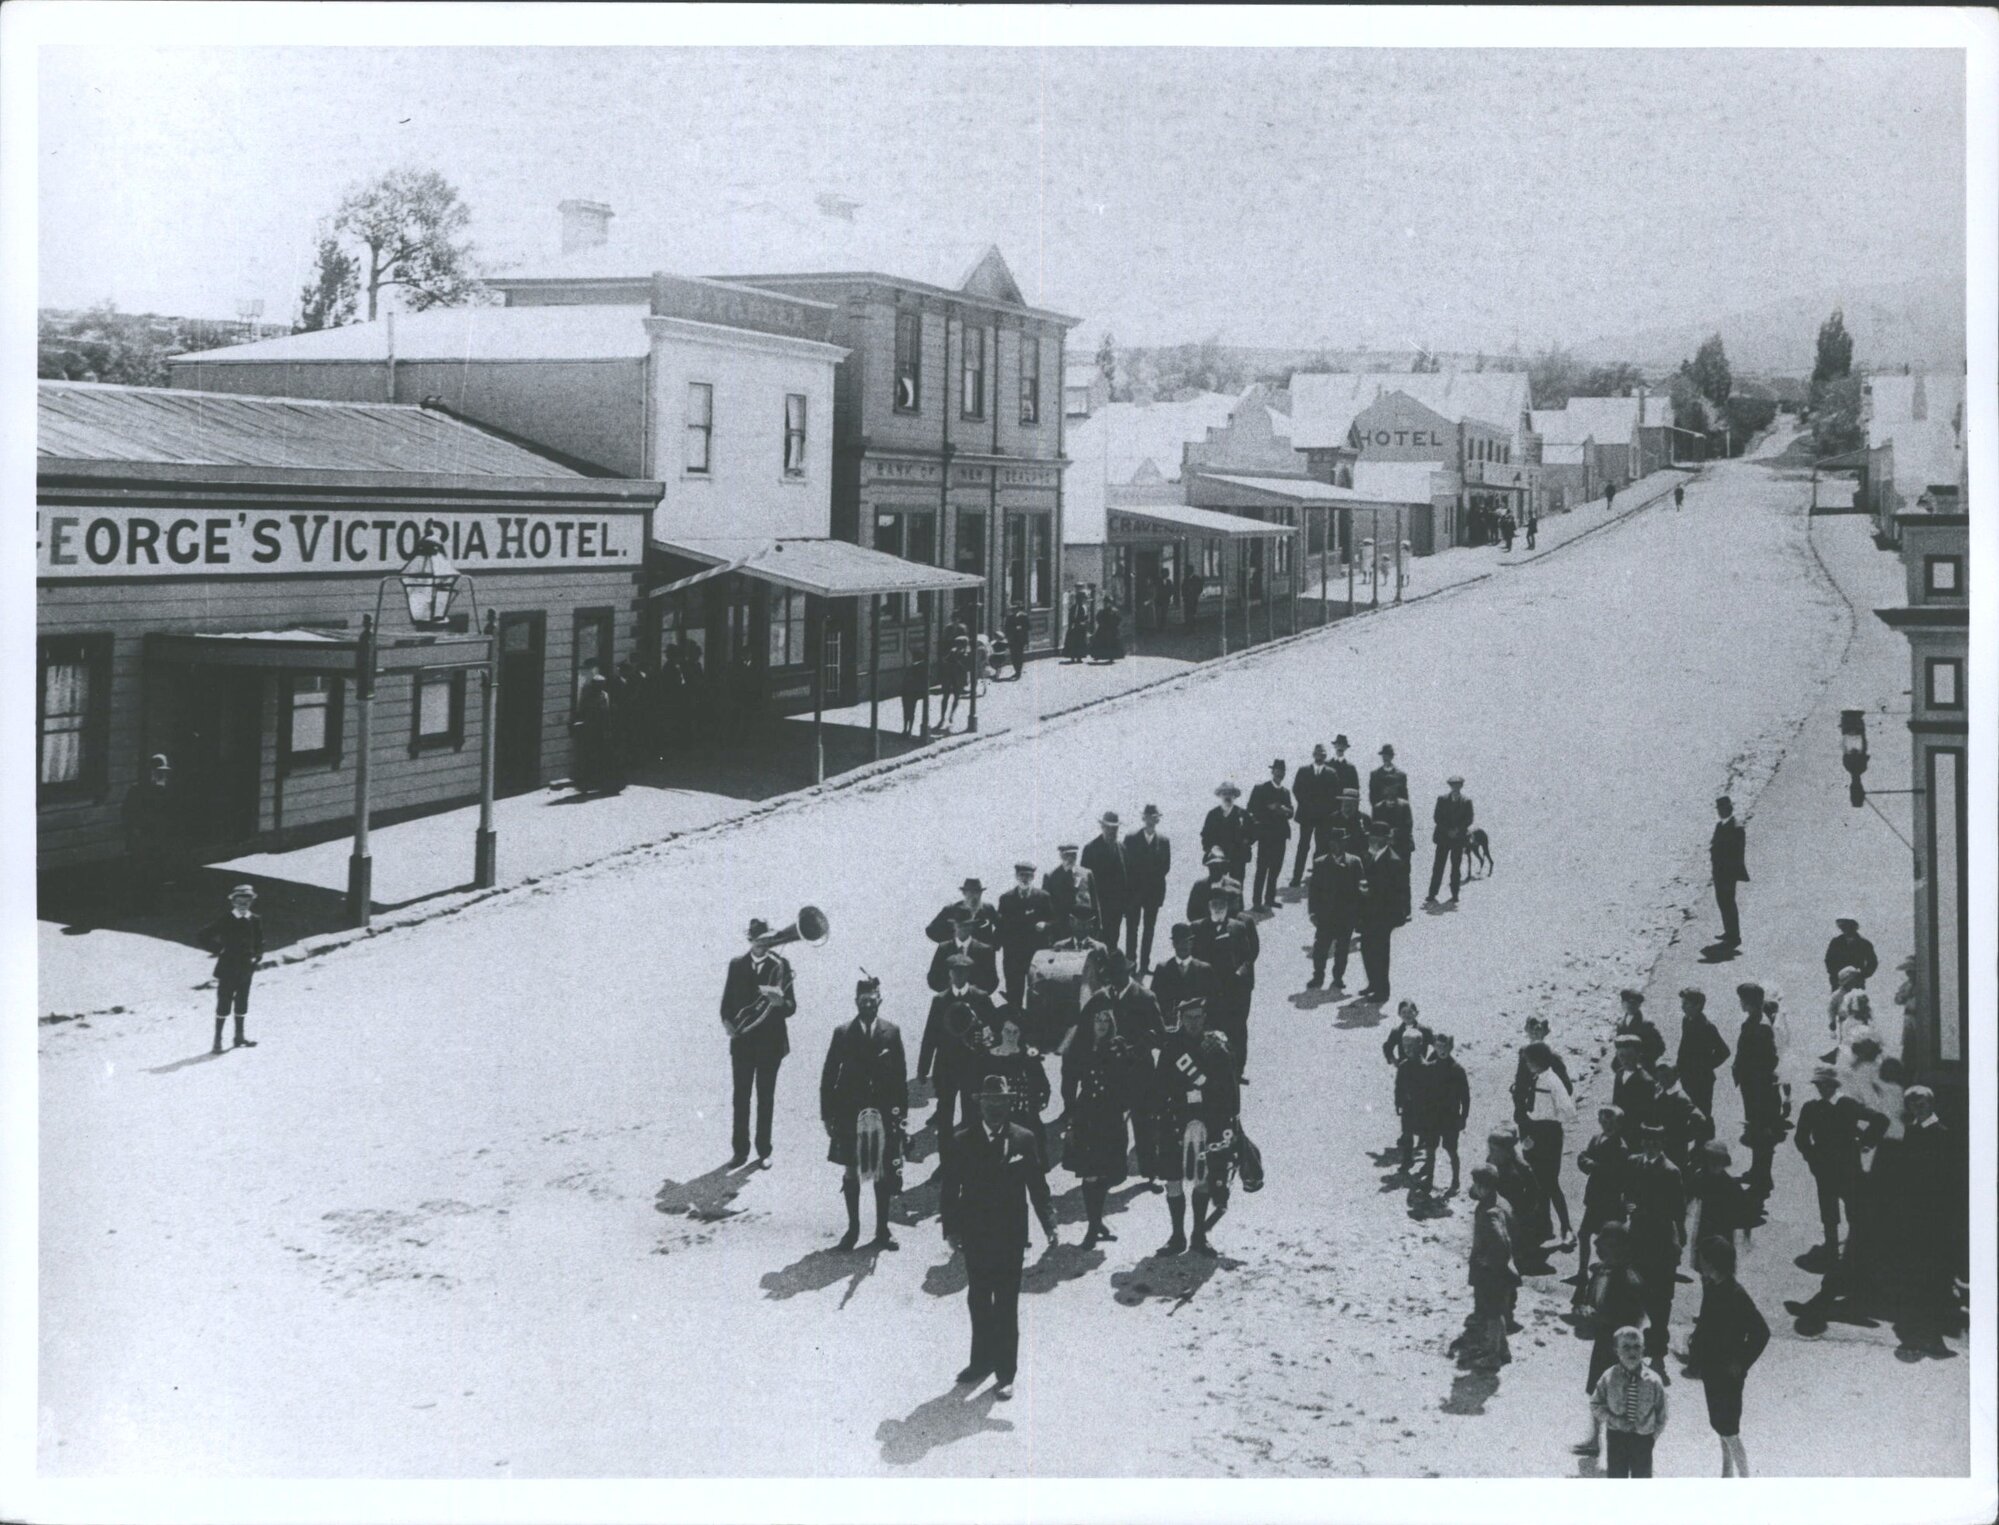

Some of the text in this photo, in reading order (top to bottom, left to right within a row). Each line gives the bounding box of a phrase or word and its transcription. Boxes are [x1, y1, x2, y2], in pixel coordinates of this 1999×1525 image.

[1359, 430, 1443, 446] HOTEL
[36, 511, 282, 565] EORGE'S
[497, 517, 628, 559] HOTEL.
